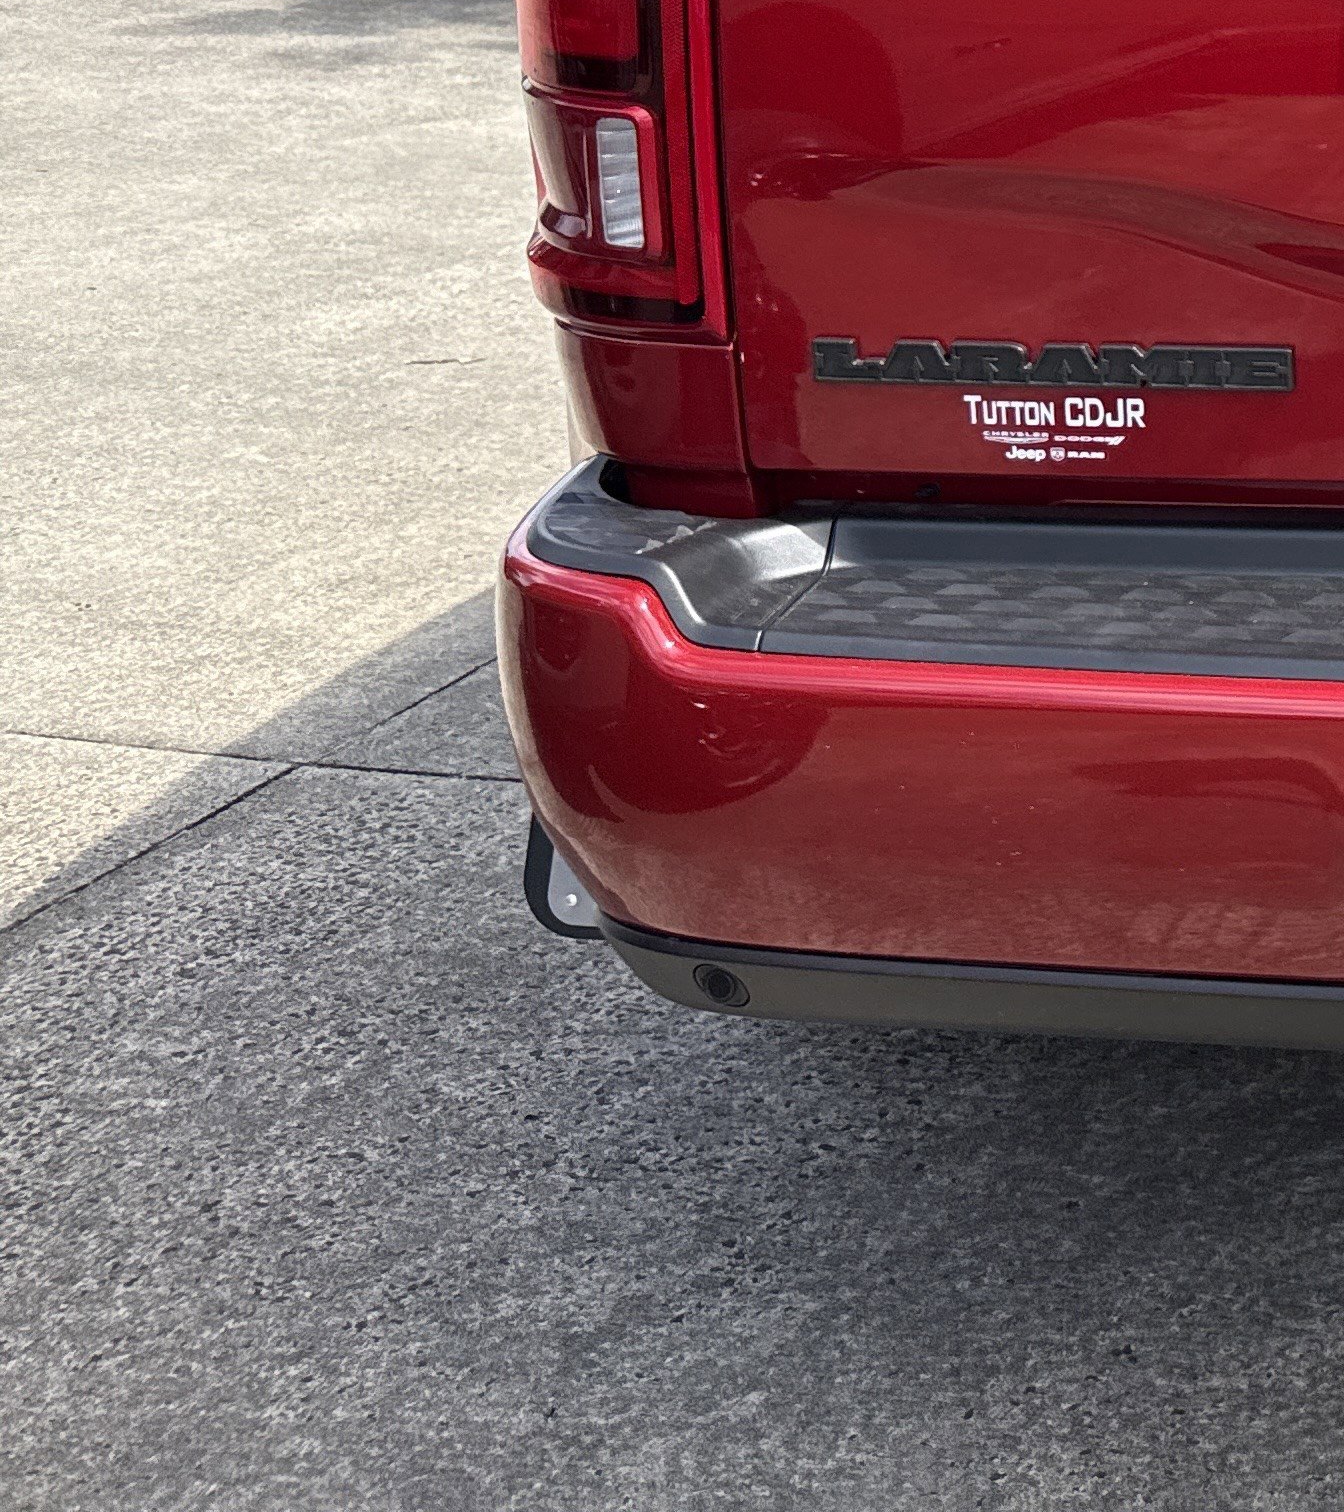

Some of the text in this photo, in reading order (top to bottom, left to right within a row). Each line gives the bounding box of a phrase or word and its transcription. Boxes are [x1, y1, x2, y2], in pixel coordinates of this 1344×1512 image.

[813, 336, 1294, 391] LARAMIE
[963, 394, 1146, 428] TUTTON CDJR
[1005, 445, 1105, 462] Jeep RAM
